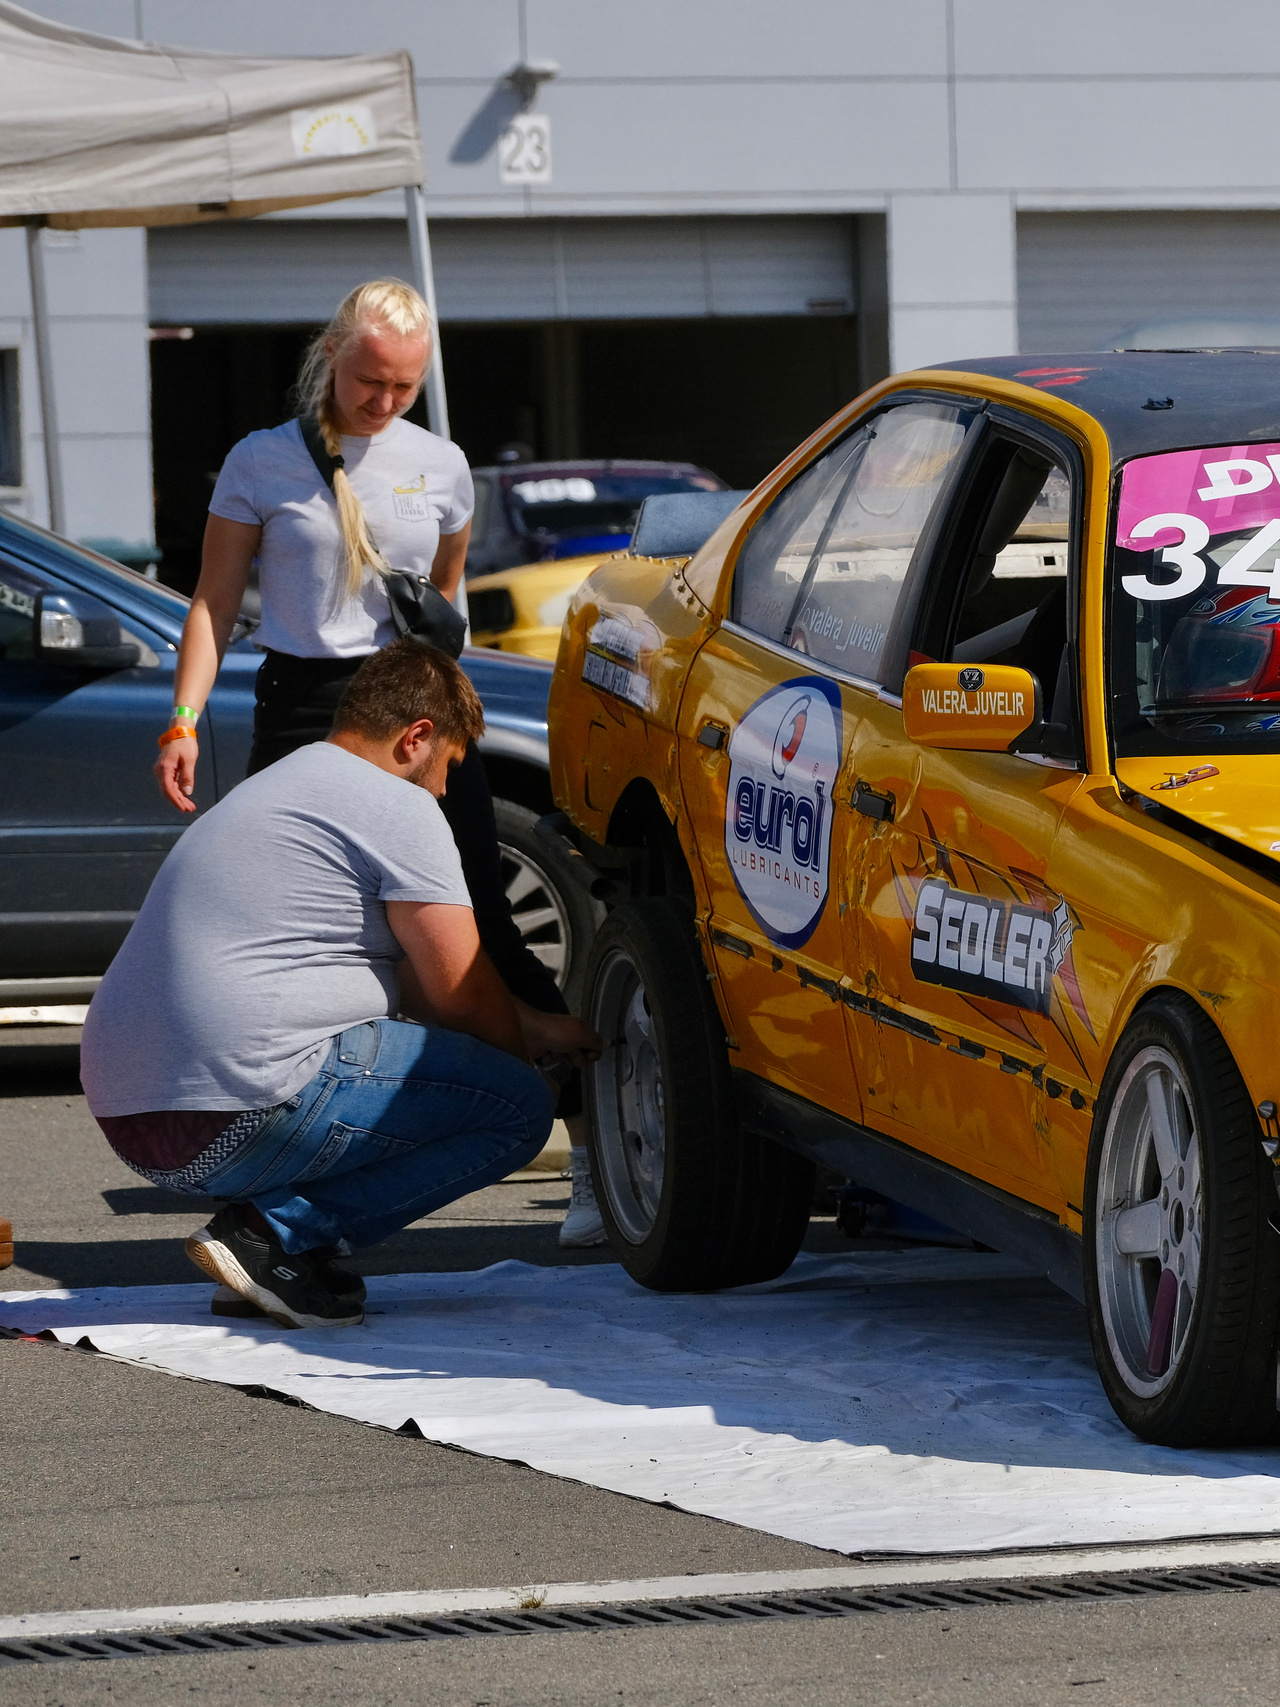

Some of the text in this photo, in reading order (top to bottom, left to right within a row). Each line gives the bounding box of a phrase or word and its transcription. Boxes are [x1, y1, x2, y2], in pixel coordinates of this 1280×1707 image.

[503, 126, 548, 173] 23
[922, 689, 1025, 716] VALERA_JUVELIR
[734, 776, 825, 874] eurol
[732, 846, 820, 899] LUBRICANTS
[913, 884, 1053, 995] SEDLER
